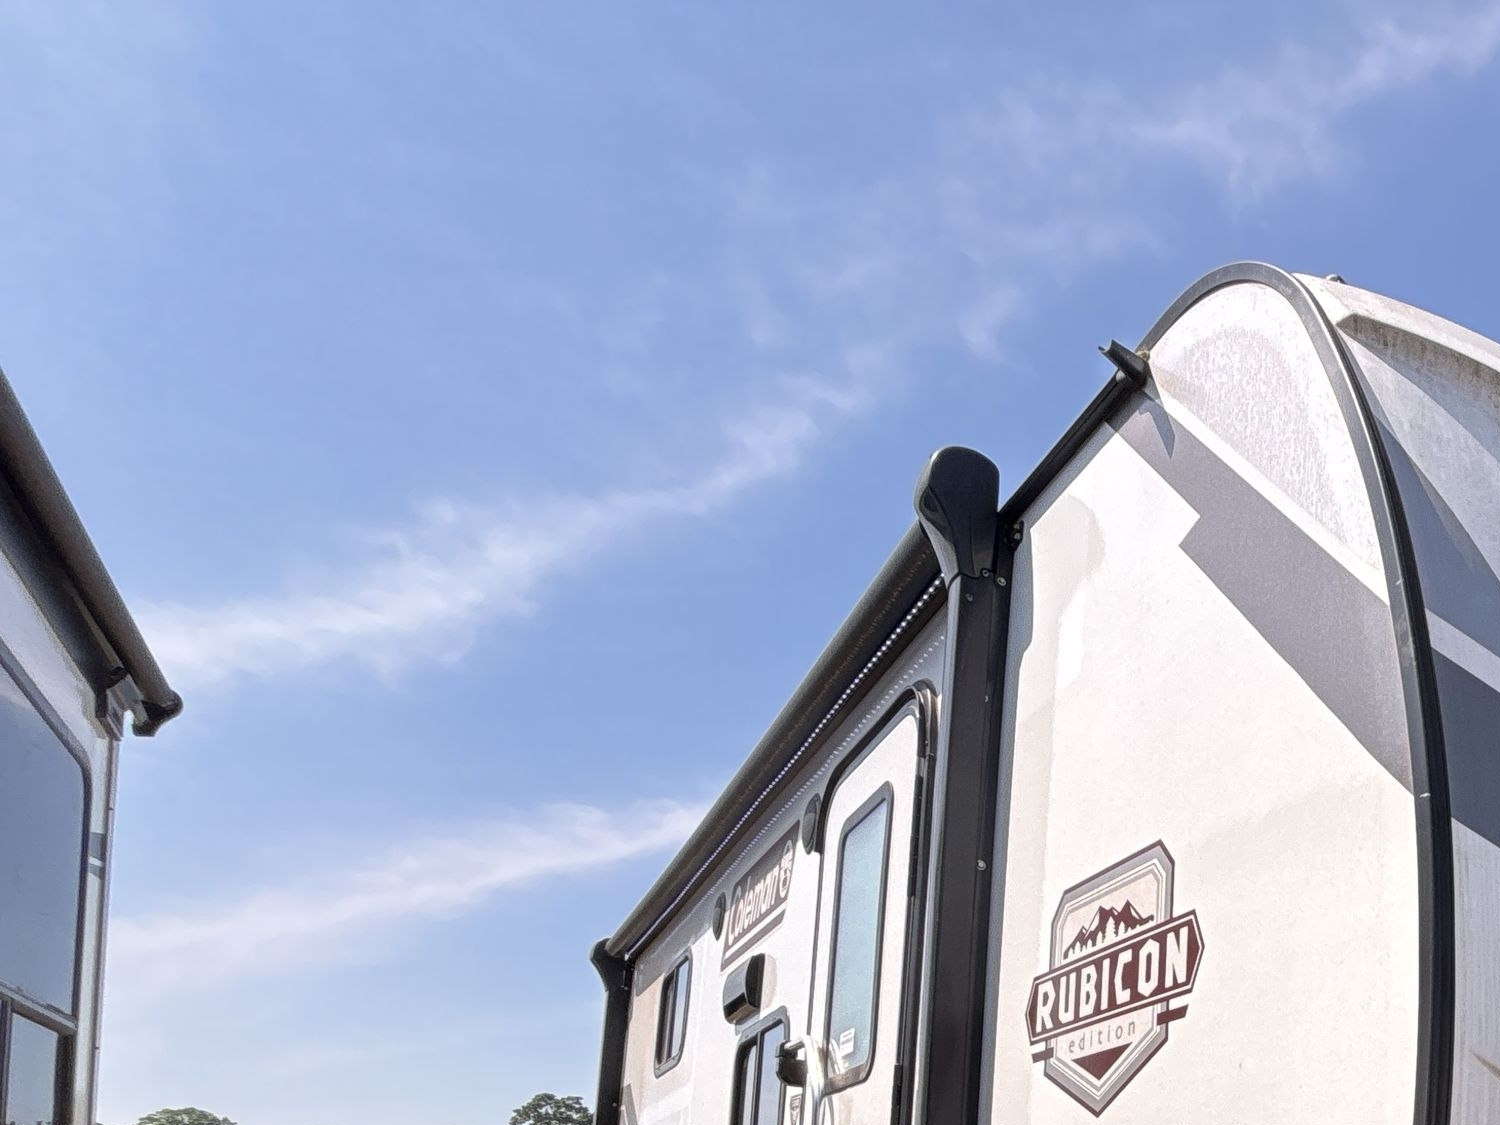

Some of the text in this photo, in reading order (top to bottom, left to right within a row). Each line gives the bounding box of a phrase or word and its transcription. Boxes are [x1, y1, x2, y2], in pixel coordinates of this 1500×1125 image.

[728, 864, 780, 946] Coleman
[1035, 925, 1189, 1034] RUBICON
[1068, 1020, 1136, 1053] edition
